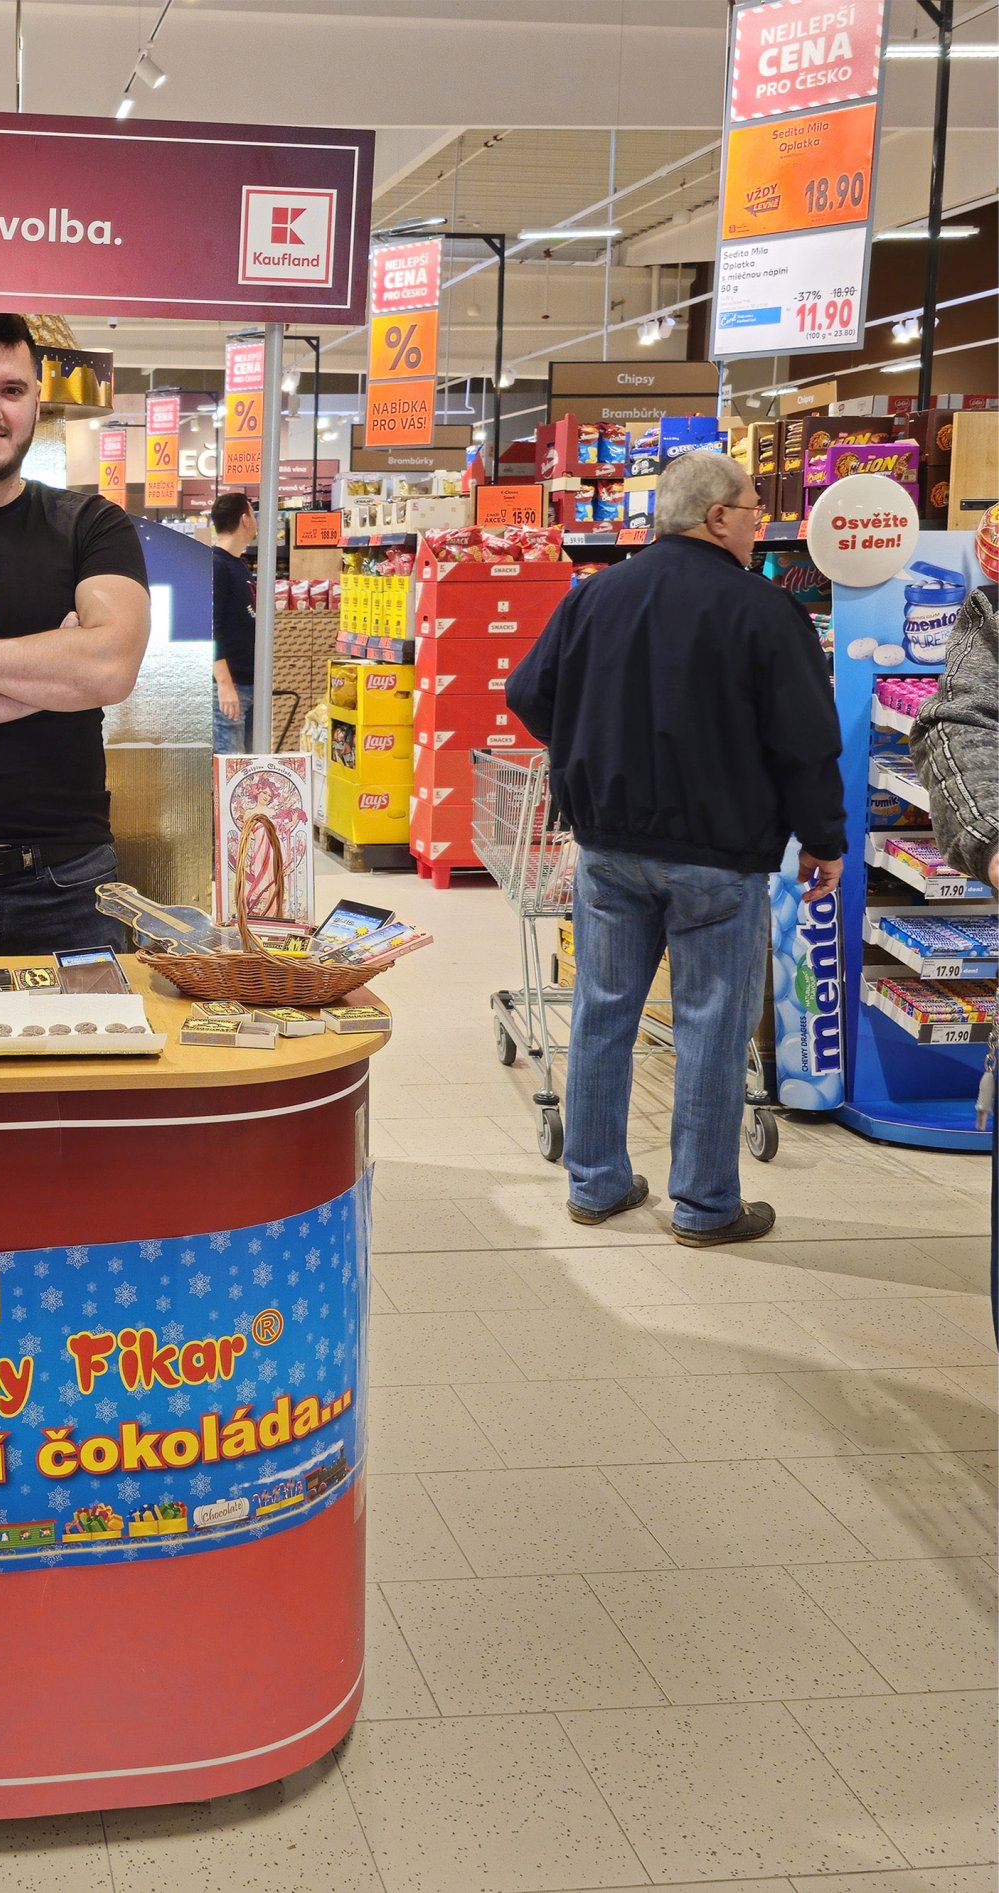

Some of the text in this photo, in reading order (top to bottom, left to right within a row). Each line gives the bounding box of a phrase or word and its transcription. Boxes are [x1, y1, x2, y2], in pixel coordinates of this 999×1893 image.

[760, 3, 856, 46] NEJLEPŠÍ
[757, 31, 853, 77] CENA
[756, 66, 852, 99] PRO ČESKO
[772, 122, 829, 140] Sedita Mila
[779, 138, 820, 153] Oplatka
[746, 183, 778, 203] VŽDY
[805, 171, 865, 214] 18.90
[252, 251, 320, 269] Kaufland
[723, 247, 768, 260] Sedita Mila
[384, 253, 429, 272] NEJLEPŠÍ
[722, 260, 755, 271] Oplatka
[383, 268, 428, 290] CENA
[383, 287, 428, 301] PRO ČESKO
[793, 290, 822, 302] -37%
[796, 299, 853, 332] 11.90
[233, 361, 262, 374] CENA
[616, 373, 655, 386] Chipsy
[372, 399, 428, 416] NABÍDKA
[602, 407, 666, 419] Brambůrky
[372, 414, 427, 431] PRO VÁS!
[227, 450, 261, 462] NABÍDKA
[388, 456, 434, 467] Brambůrky
[227, 462, 260, 474] PRO VÁS
[512, 511, 536, 524] 15.90
[831, 512, 908, 530] Osvěžte
[838, 534, 902, 550] si den!
[940, 885, 964, 897] 17.90
[799, 866, 840, 1076] mento
[936, 965, 960, 977] 17.90
[945, 1030, 969, 1042] 17.90
[66, 1326, 247, 1395] Fikar
[36, 1388, 353, 1480] čokoláda...
[201, 1500, 243, 1526] Chocolate
